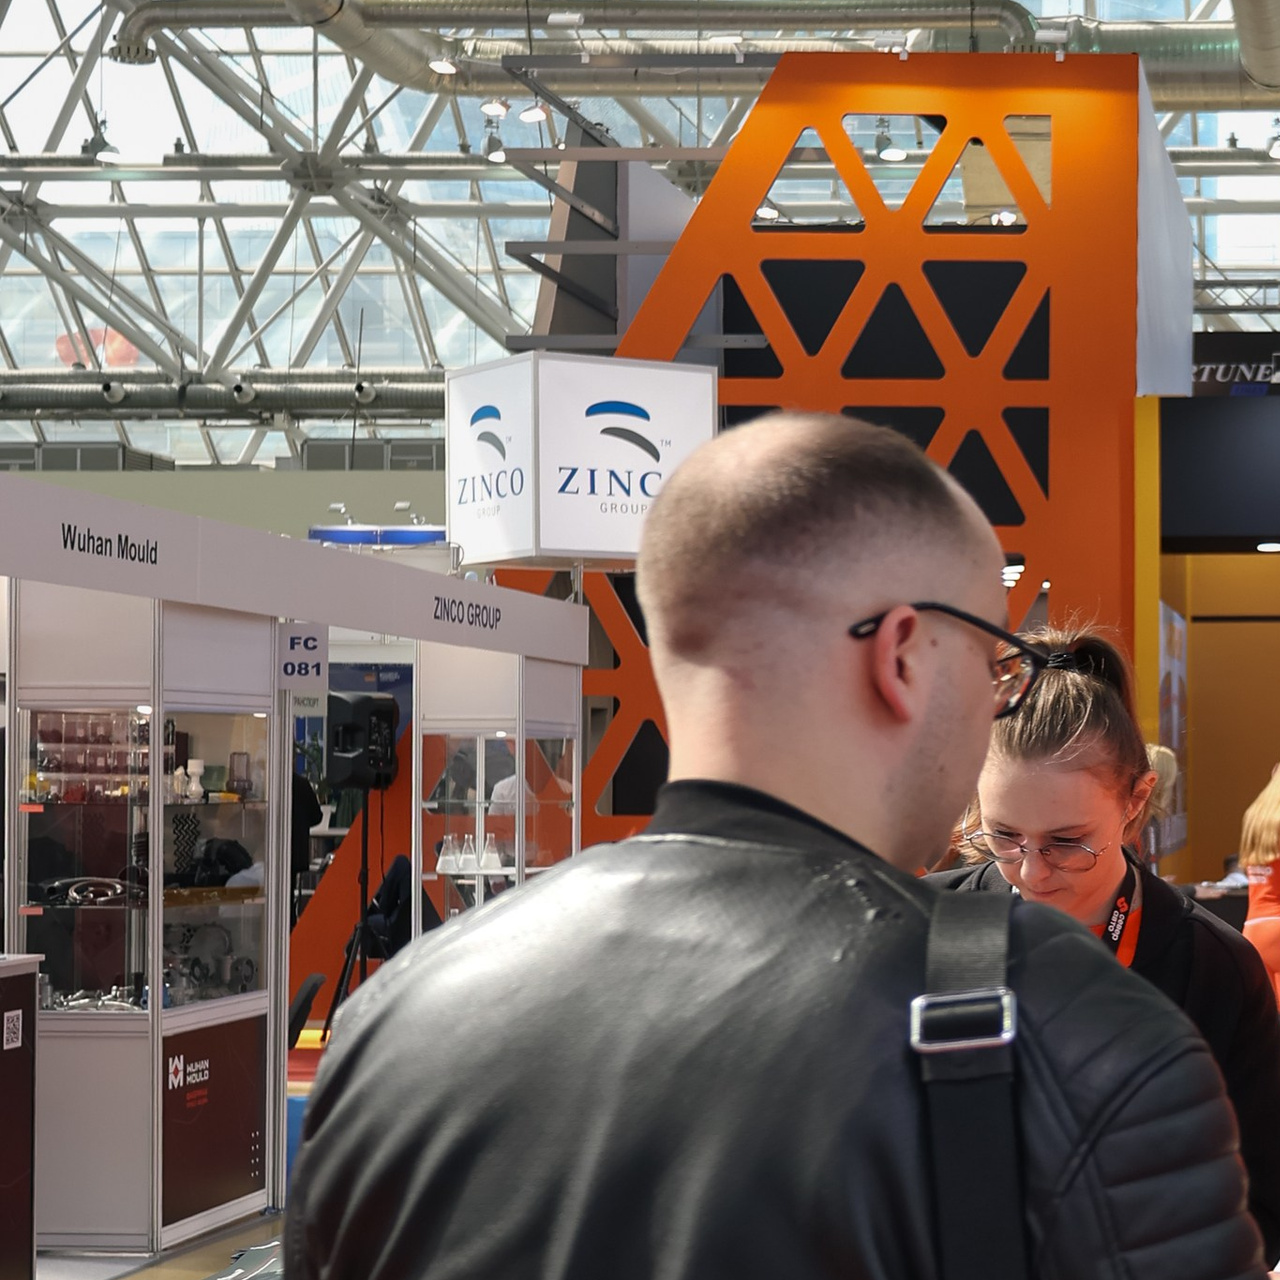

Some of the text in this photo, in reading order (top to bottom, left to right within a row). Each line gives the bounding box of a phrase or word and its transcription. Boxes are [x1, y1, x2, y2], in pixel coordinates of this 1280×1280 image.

[457, 467, 524, 506] ZINCO
[557, 467, 663, 498] ZINC
[61, 523, 158, 565] Wuhan Mould
[433, 596, 501, 630] ZINCO GROUP
[289, 636, 318, 651] FC
[283, 662, 321, 676] 081
